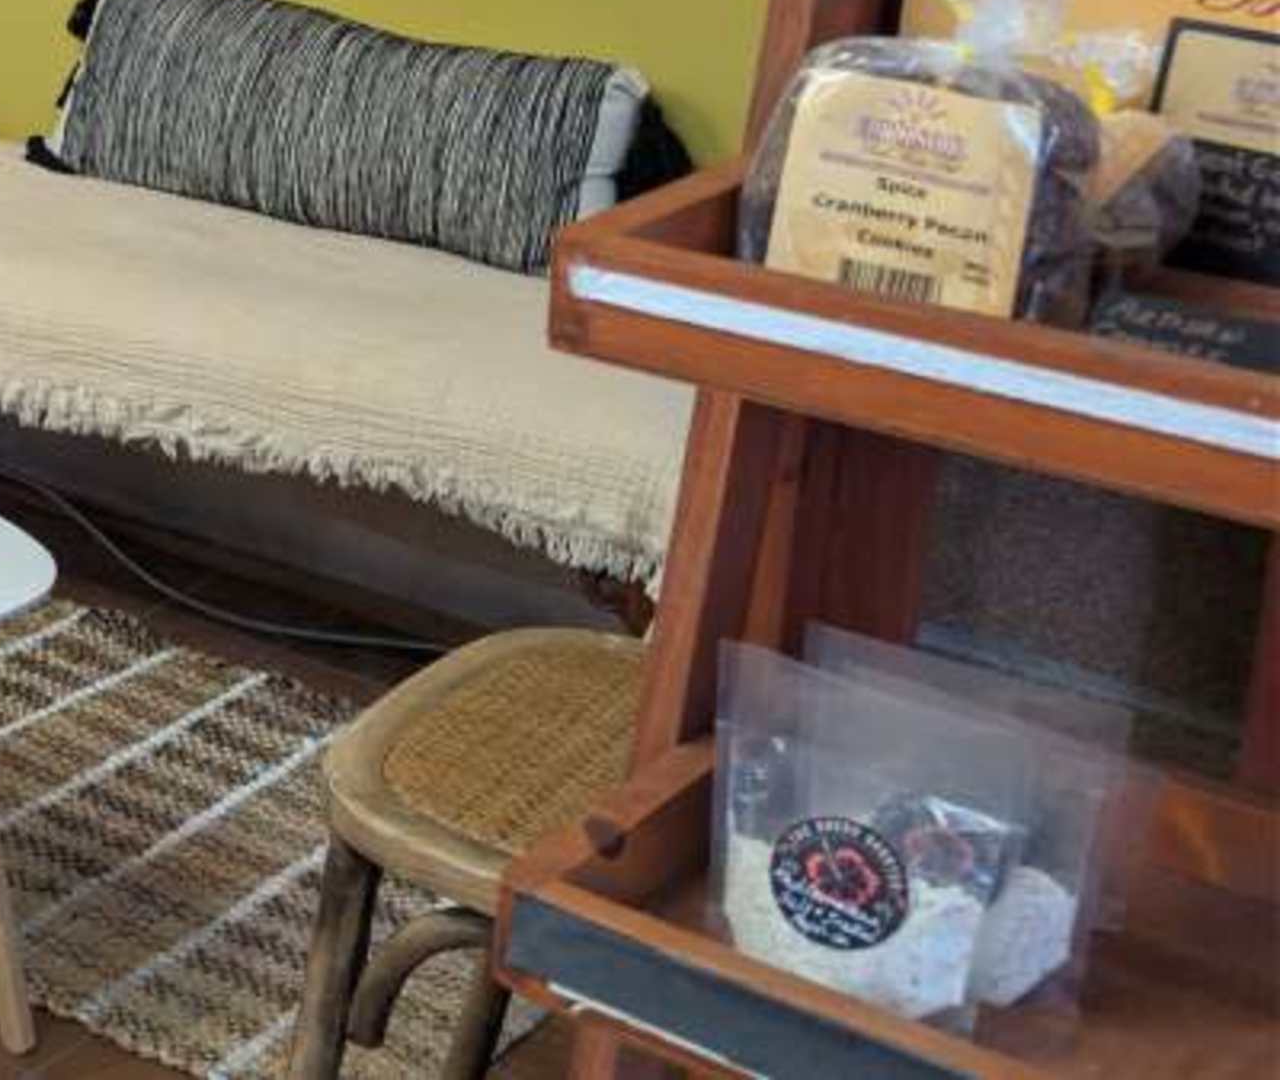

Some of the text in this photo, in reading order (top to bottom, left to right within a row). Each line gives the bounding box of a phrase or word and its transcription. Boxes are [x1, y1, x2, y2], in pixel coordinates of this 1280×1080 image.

[876, 176, 928, 200] Spice
[811, 192, 990, 244] Cranberry Pecan
[856, 228, 934, 259] Cookies
